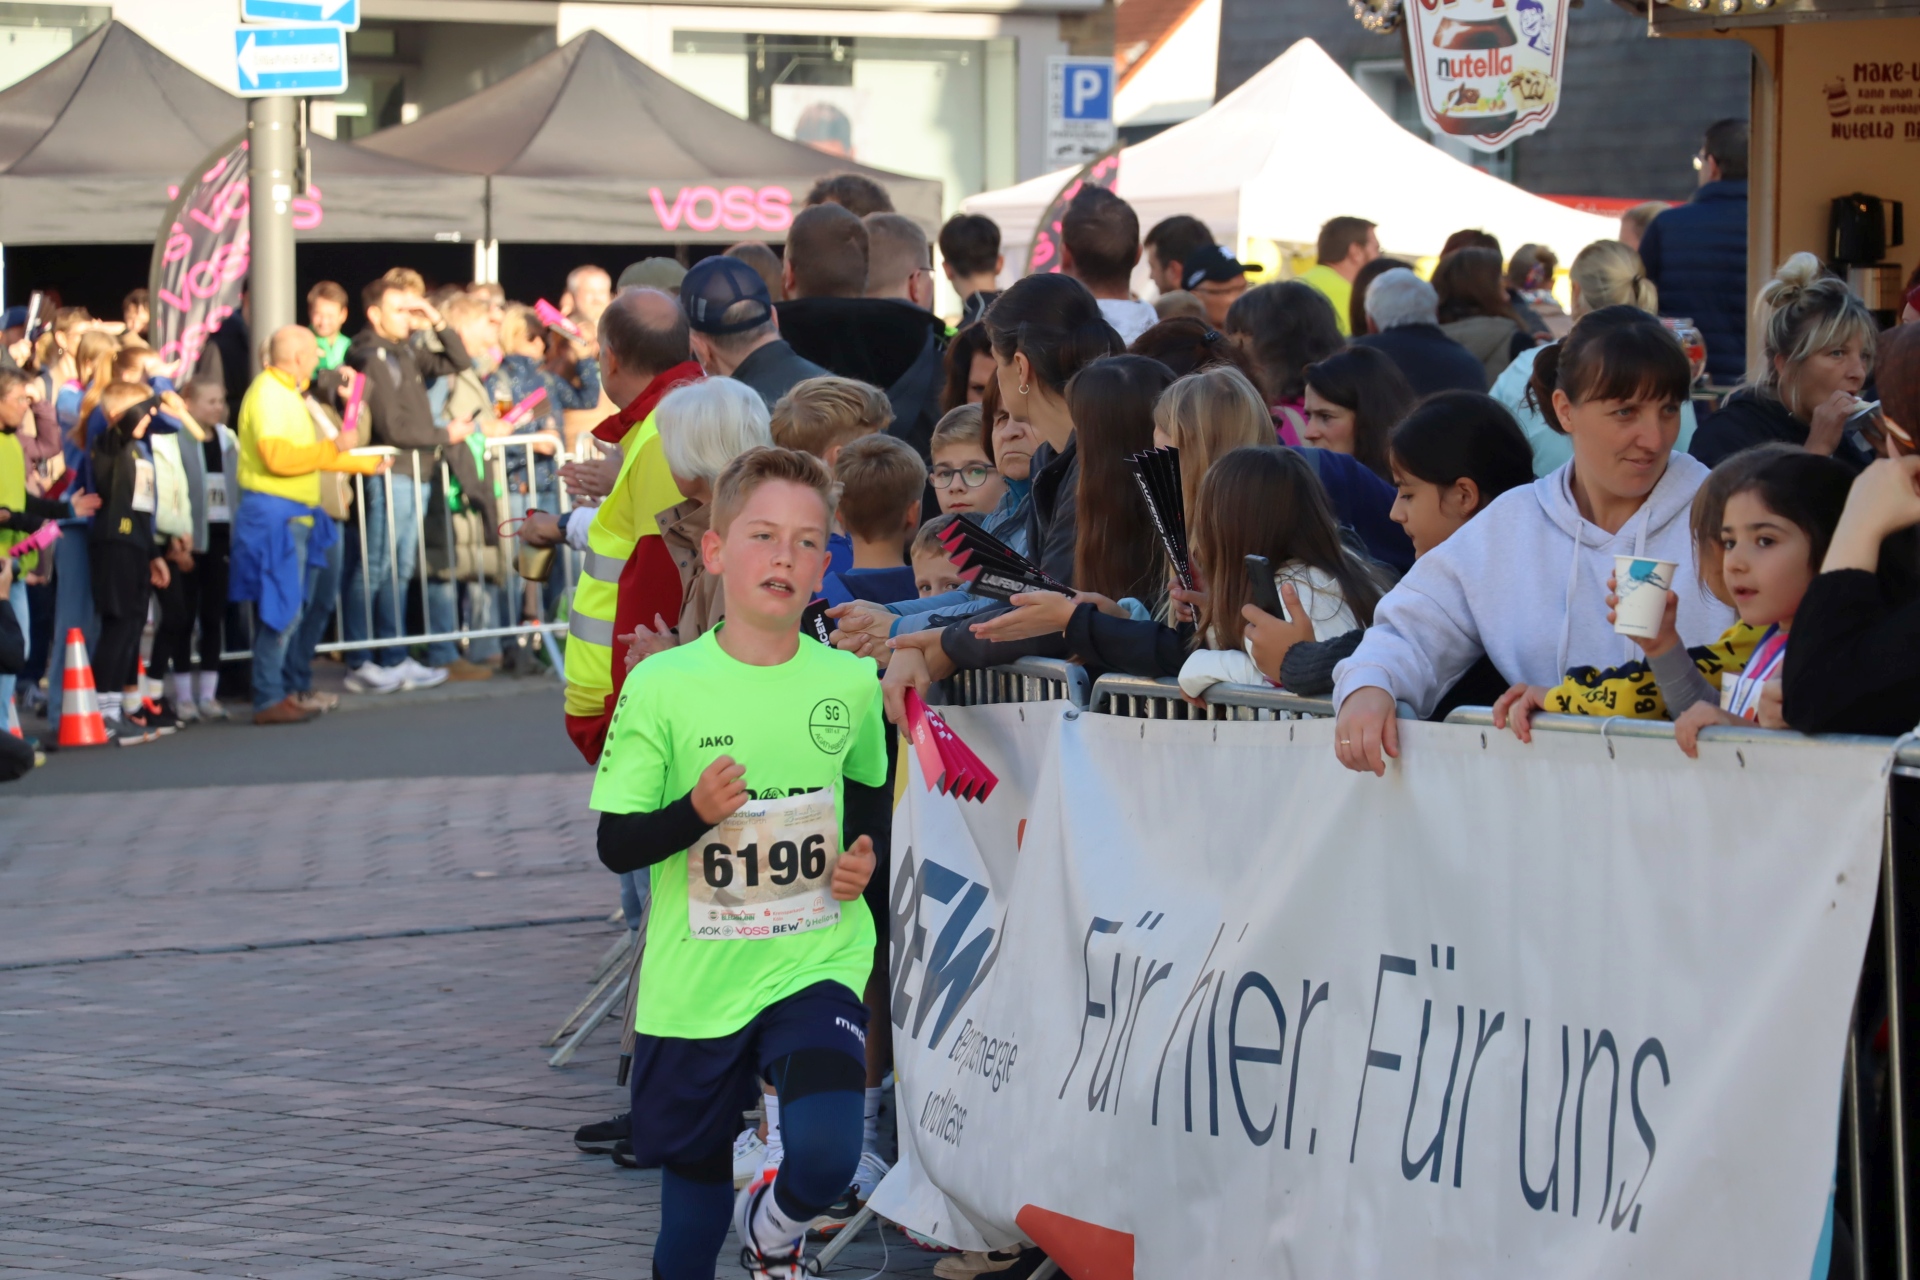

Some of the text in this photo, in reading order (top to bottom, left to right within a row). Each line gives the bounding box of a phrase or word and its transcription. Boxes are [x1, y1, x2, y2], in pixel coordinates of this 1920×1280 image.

[1437, 48, 1512, 79] nutella
[1072, 69, 1103, 117] P
[648, 185, 794, 232] VOSS
[825, 704, 840, 721] SG
[699, 735, 734, 748] JAKO
[702, 833, 827, 889] 6196
[698, 914, 835, 936] AOK VOSS BEW Helios
[1349, 943, 1506, 1189] Für
